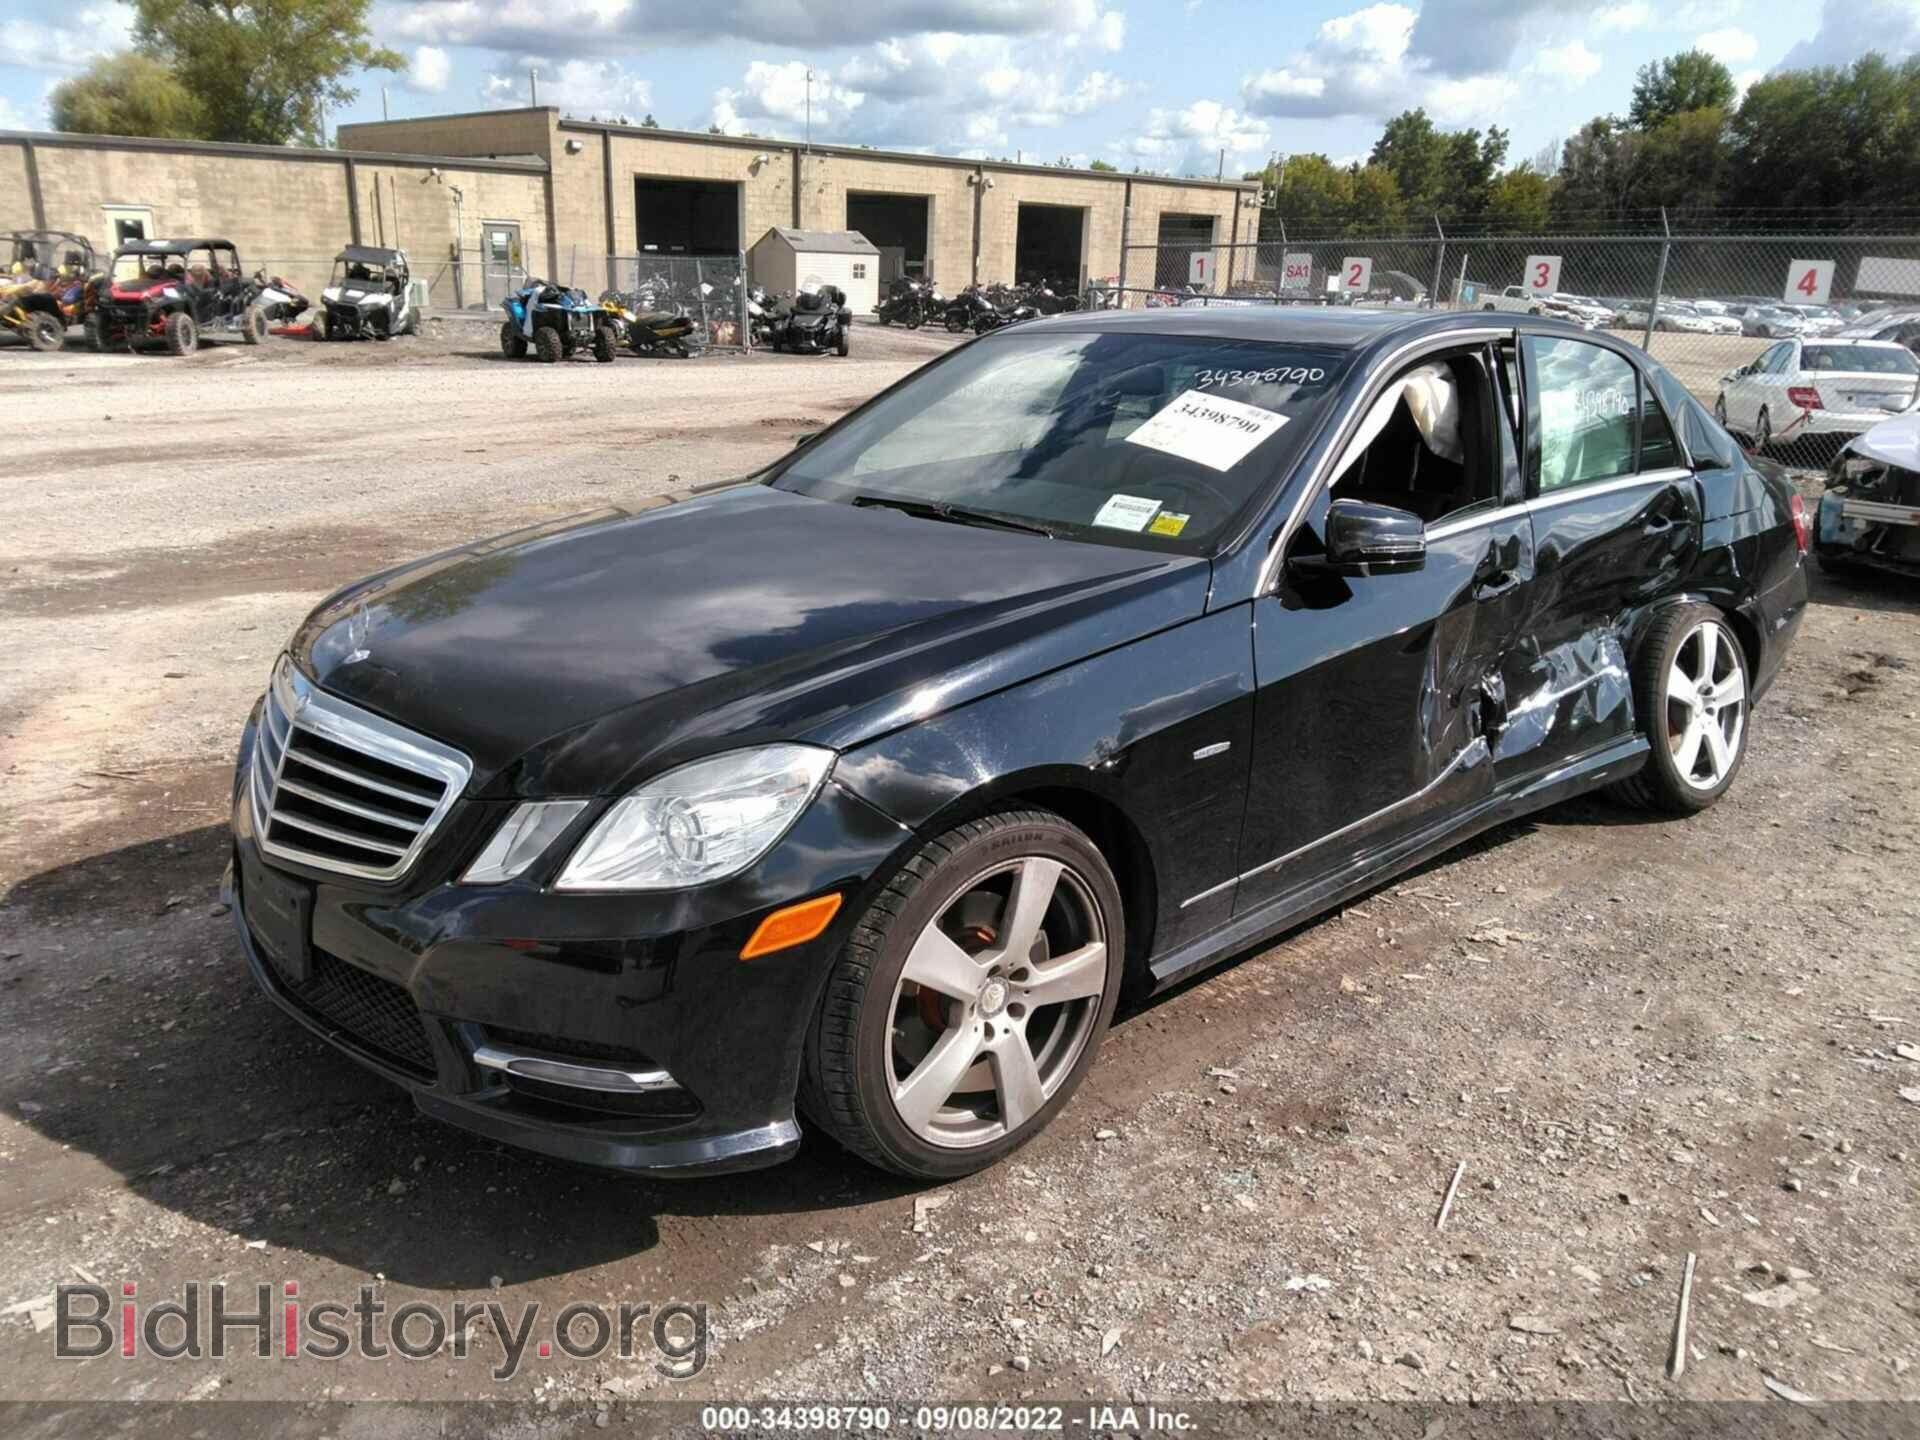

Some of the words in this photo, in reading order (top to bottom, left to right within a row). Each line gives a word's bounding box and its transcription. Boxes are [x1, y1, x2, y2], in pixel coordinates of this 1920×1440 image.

[1195, 258, 1205, 279] 1
[1286, 267, 1310, 279] SA1
[1348, 264, 1363, 287] 2
[1533, 263, 1550, 288] 3
[1797, 268, 1818, 296] 4
[1173, 403, 1261, 433] 34398790
